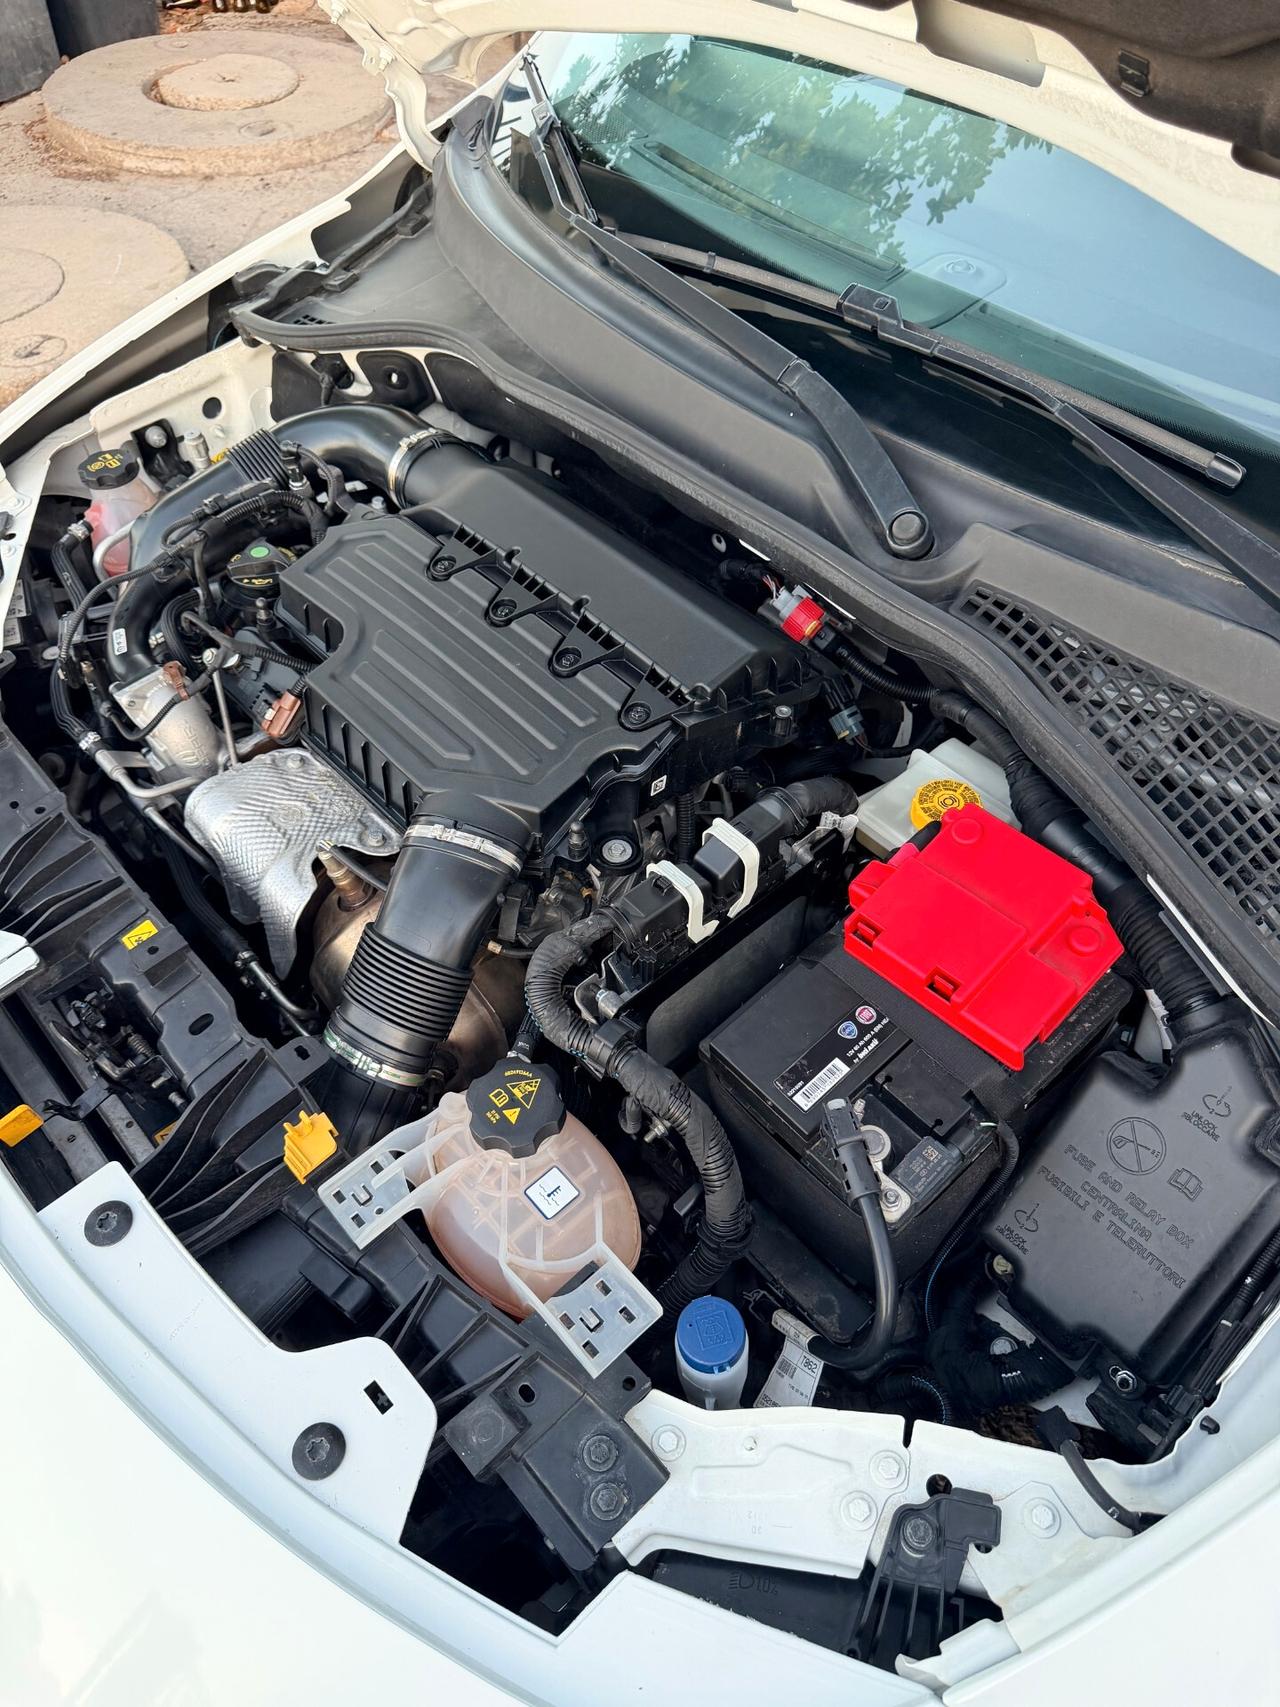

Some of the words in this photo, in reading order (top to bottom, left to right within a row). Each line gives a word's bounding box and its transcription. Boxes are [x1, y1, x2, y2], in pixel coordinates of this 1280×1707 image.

[1182, 1111, 1220, 1142] SBLOCCARE
[1191, 1110, 1218, 1131] UNLOCK
[1063, 1144, 1097, 1173] FUSE
[1097, 1171, 1124, 1194] AND
[1125, 1191, 1167, 1226] RELAY
[1166, 1224, 1195, 1249] BOX
[1079, 1180, 1153, 1242] CENTRALINA
[1004, 1224, 1027, 1246] UNLOCK
[1037, 1165, 1091, 1212] FUSIBILI
[1092, 1209, 1105, 1223] E
[1105, 1219, 1187, 1289] TELERUTTORI
